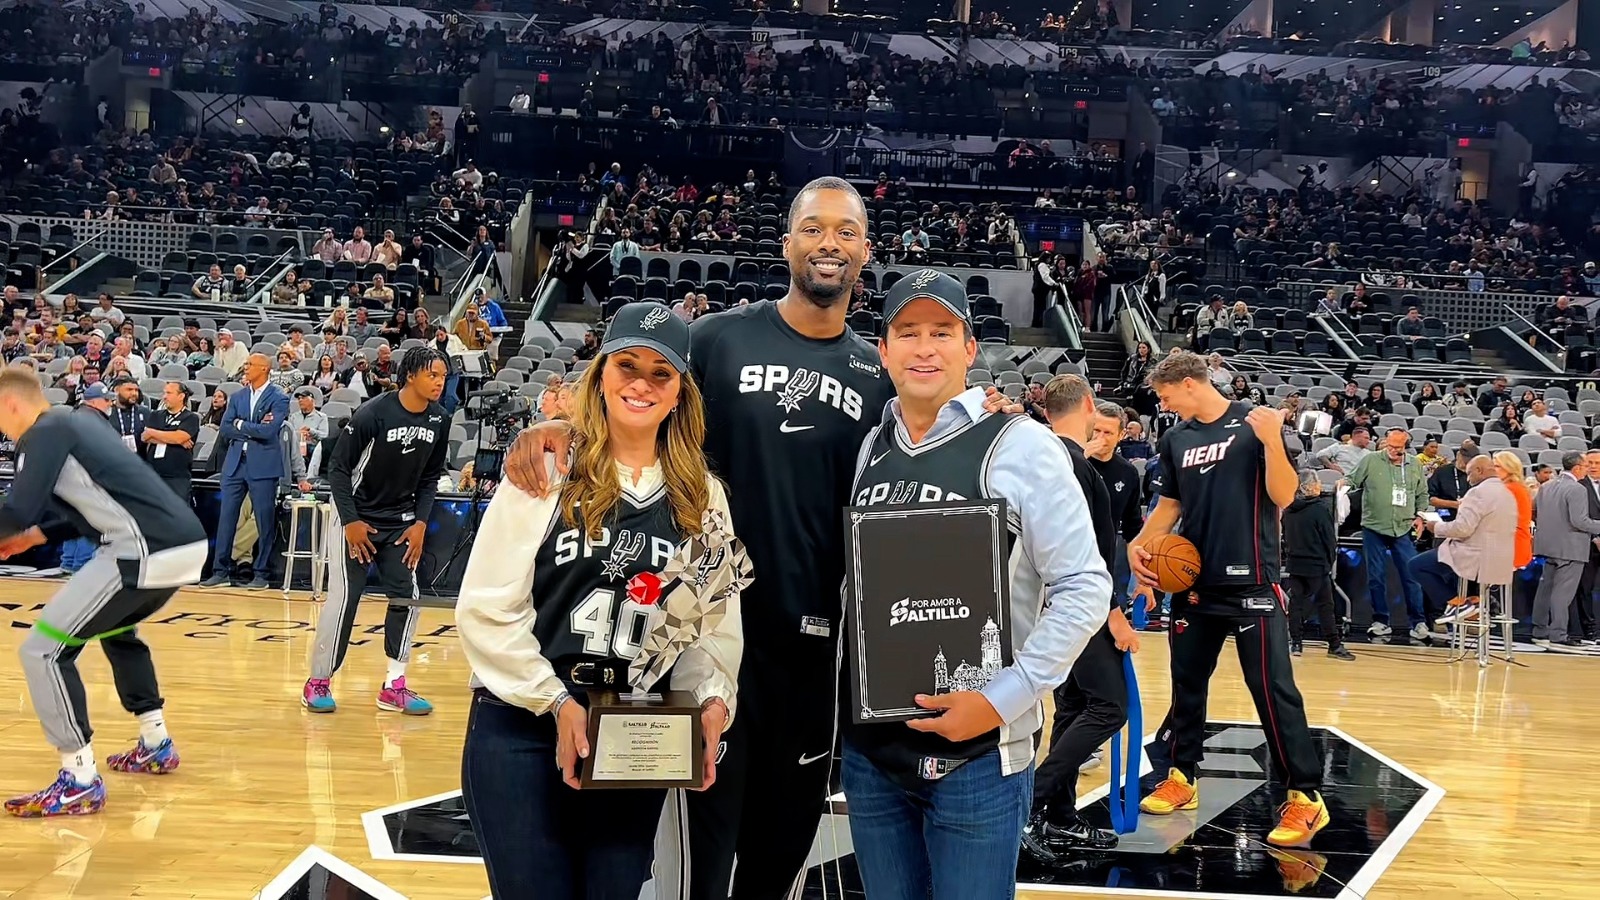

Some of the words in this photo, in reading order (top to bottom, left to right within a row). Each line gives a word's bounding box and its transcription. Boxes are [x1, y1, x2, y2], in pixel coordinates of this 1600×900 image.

[751, 31, 768, 42] 107
[1423, 66, 1441, 77] 109
[852, 358, 878, 375] LEDGER
[738, 364, 864, 421] SPURS
[386, 425, 435, 446] SPURS
[1181, 434, 1236, 468] HEAT
[855, 480, 968, 507] SPUR
[555, 526, 676, 582] SPUR
[890, 597, 970, 627] SALTILLO
[911, 600, 929, 608] POR
[930, 598, 955, 608] AMOR
[956, 597, 962, 605] A
[570, 587, 661, 660] 40
